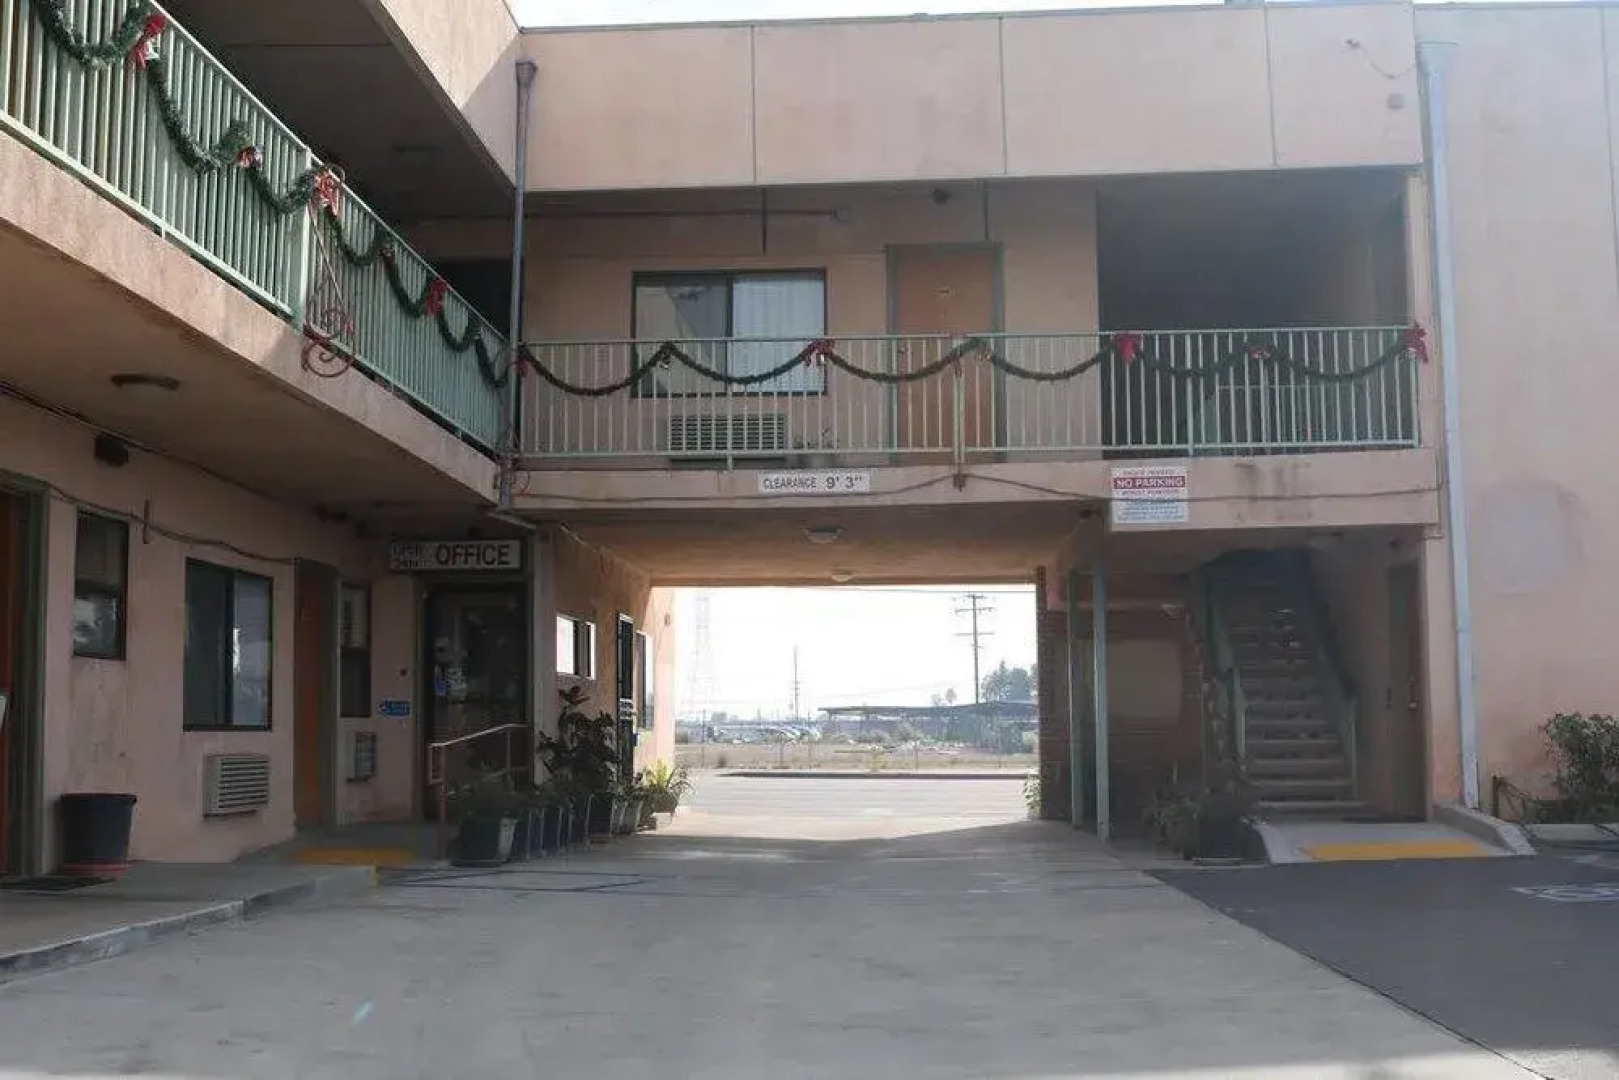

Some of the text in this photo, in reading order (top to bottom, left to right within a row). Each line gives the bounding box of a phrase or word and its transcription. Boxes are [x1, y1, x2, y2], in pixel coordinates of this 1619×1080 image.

[763, 476, 817, 490] CLEARANCE
[826, 475, 840, 490] 9'
[1116, 476, 1184, 488] NO PARKING
[436, 544, 510, 566] OFFICE
